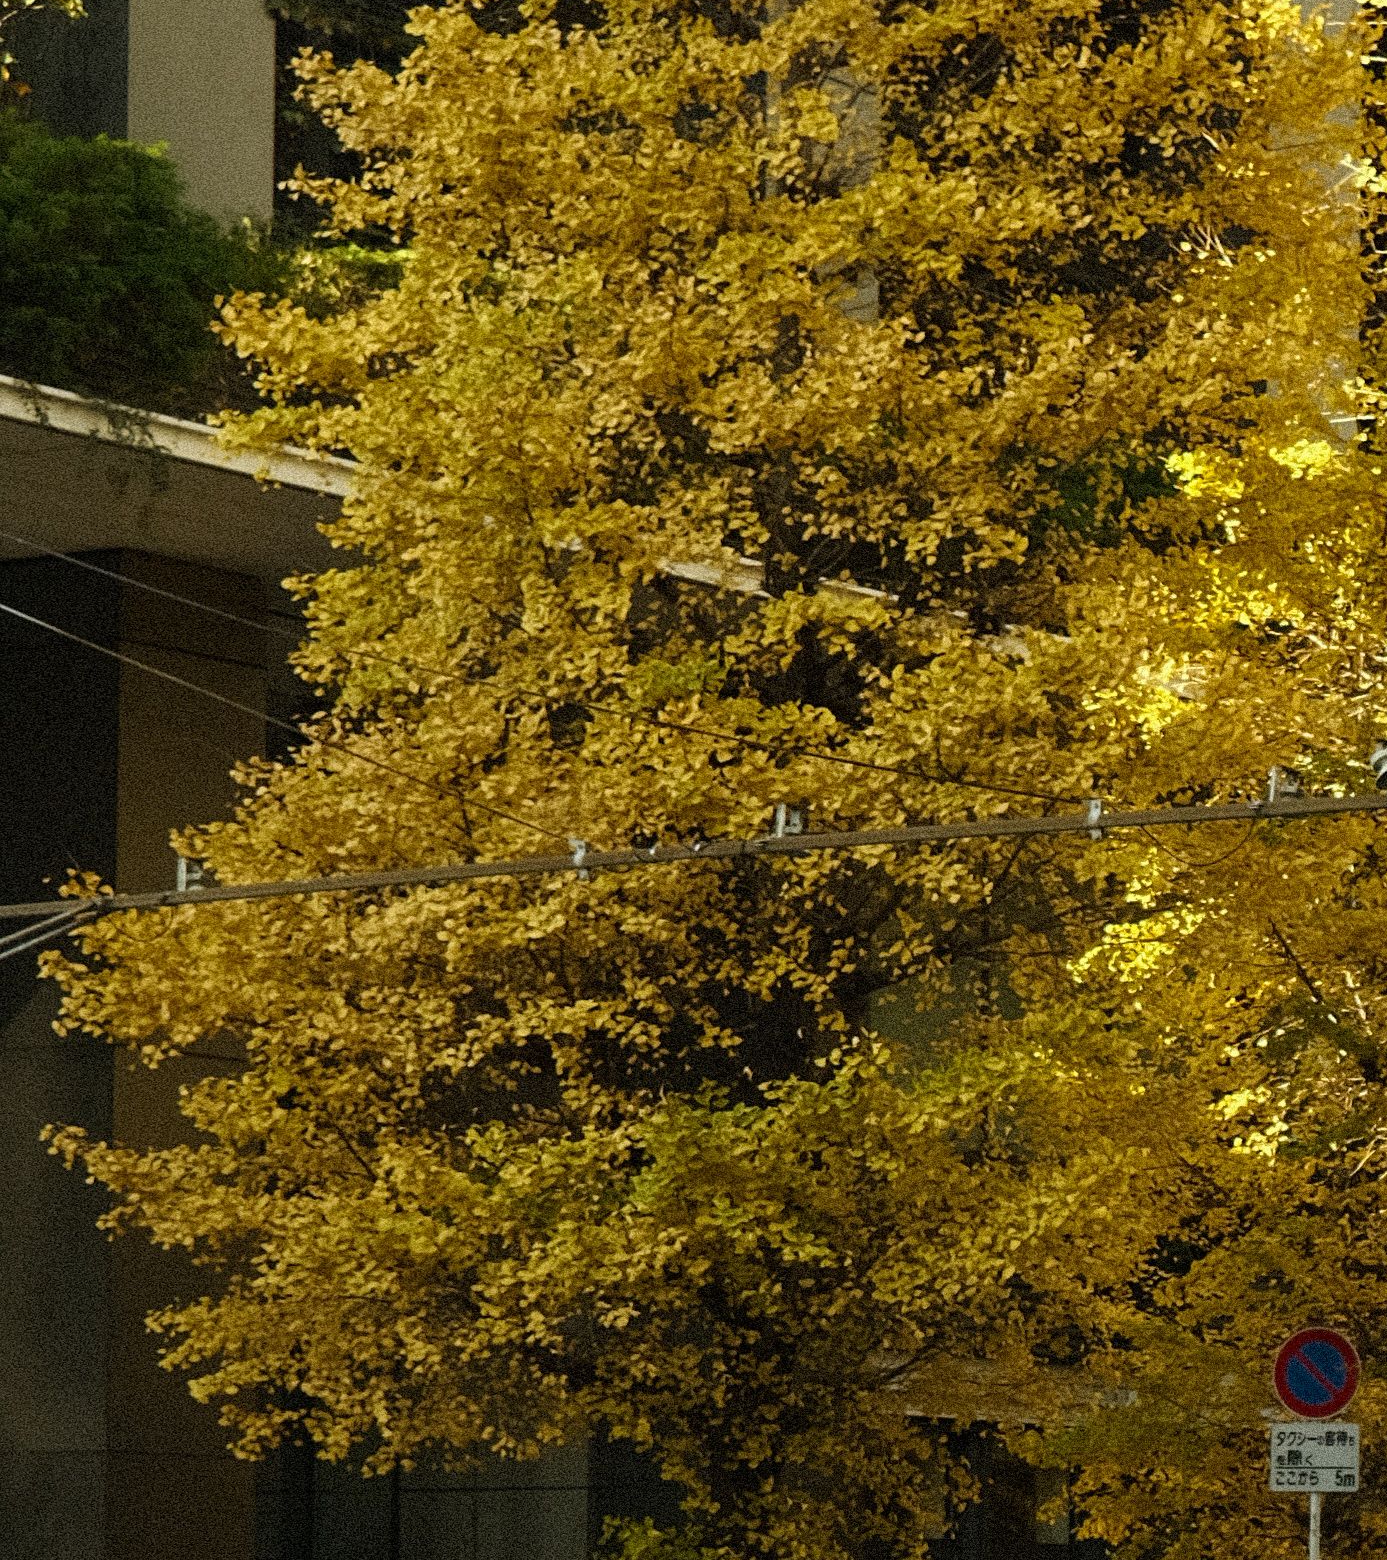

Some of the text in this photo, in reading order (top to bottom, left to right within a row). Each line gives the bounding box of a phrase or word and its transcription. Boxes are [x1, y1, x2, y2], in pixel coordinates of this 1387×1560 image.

[1277, 1449, 1313, 1466] を除く
[1276, 1470, 1356, 1487] ここから 5m
